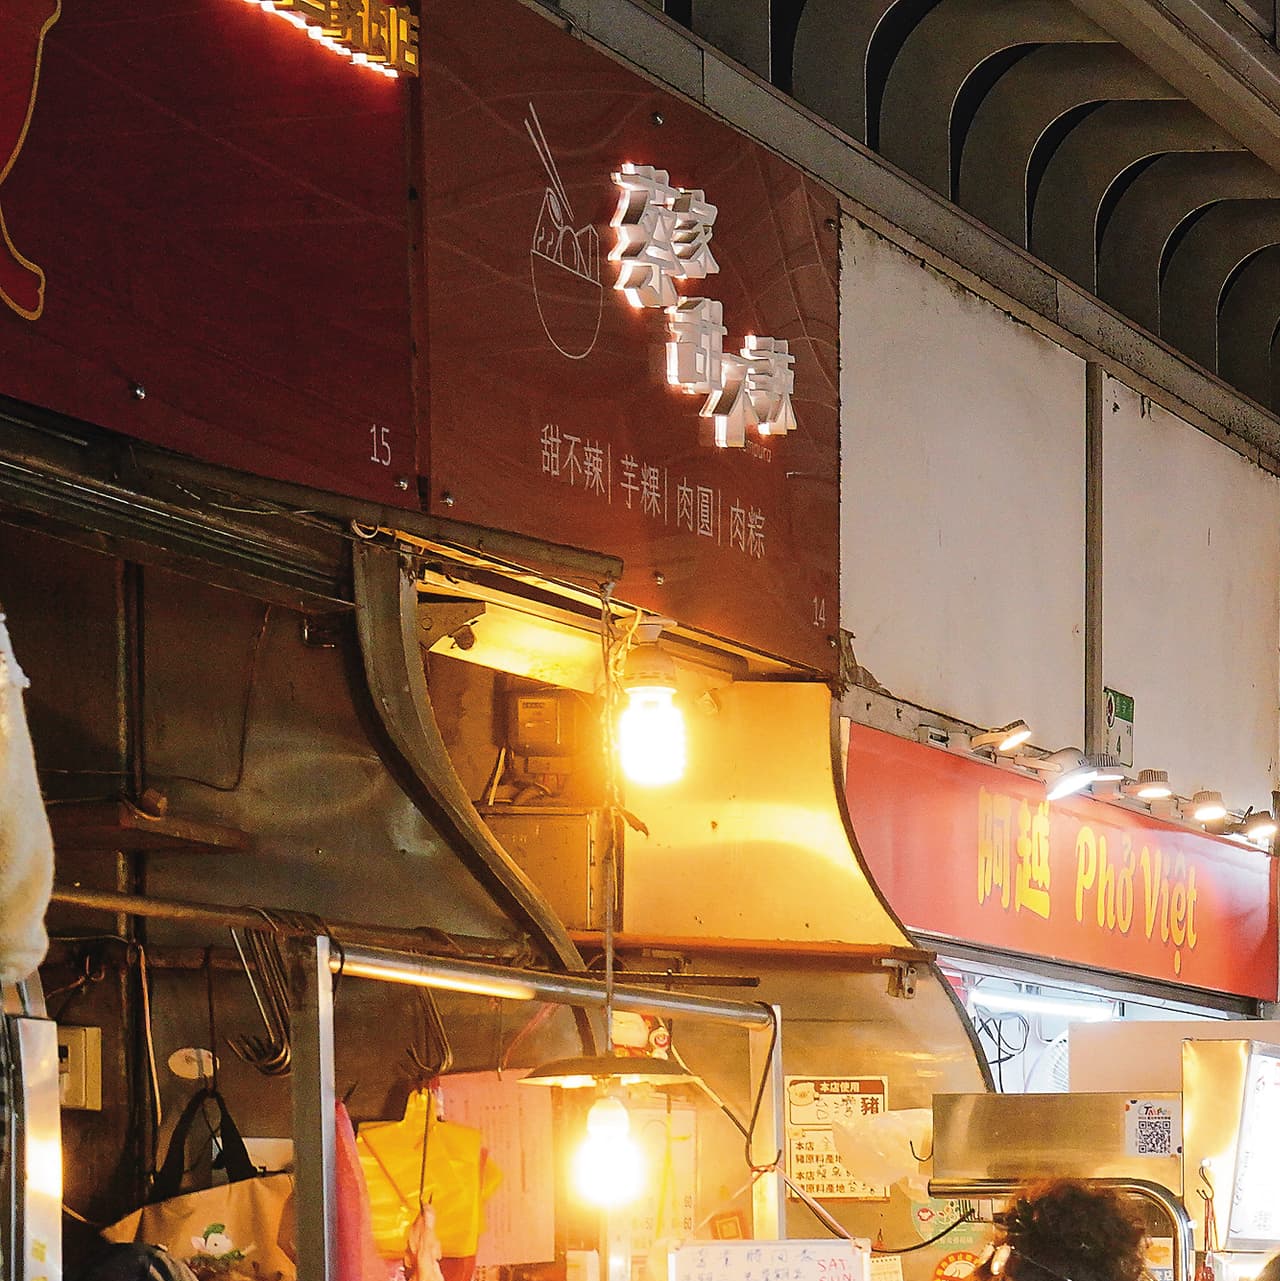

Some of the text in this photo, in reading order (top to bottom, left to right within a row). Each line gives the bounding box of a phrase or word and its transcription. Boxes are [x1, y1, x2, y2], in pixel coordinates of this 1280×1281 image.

[608, 163, 720, 309] 蔡家
[664, 296, 797, 448] 甜不辣
[370, 424, 392, 467] 15
[540, 424, 767, 560] 甜不辣 芋粿 肉圓 肉粽
[812, 596, 827, 629] 14
[819, 1081, 860, 1093] 本店使用
[860, 1096, 880, 1116] 豬
